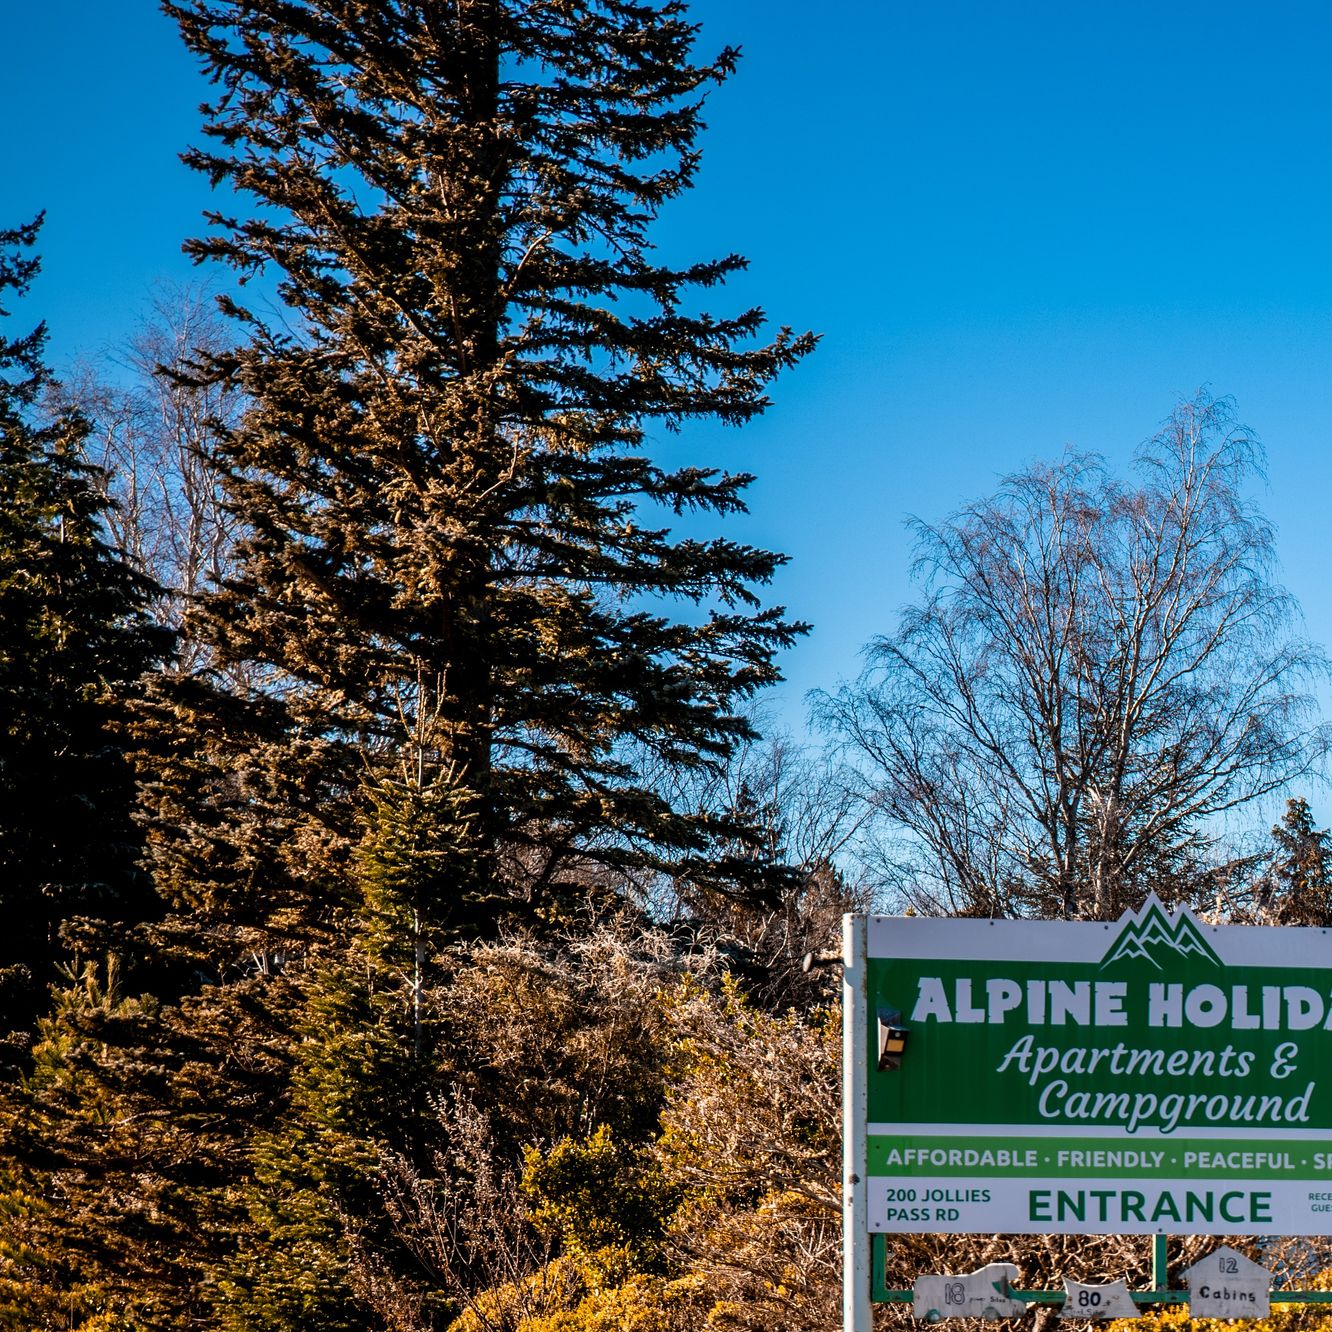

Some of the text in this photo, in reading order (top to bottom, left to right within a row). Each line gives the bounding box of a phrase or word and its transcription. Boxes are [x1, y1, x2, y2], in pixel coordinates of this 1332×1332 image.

[911, 976, 1128, 1026] ALPINE
[997, 1034, 1299, 1085] Apartments &
[1038, 1078, 1315, 1133] Campground
[886, 1149, 1038, 1168] AFFORDABLE
[1057, 1150, 1165, 1169] FRIENDLY
[1184, 1151, 1296, 1169] PEACEFUL
[886, 1188, 991, 1203] 200 JOLLIES
[887, 1208, 960, 1221] PASS RD
[1029, 1190, 1273, 1223] ENTRANCE
[1219, 1257, 1239, 1274] 12
[944, 1282, 965, 1305] 18
[1078, 1290, 1101, 1307] 80
[1199, 1285, 1256, 1302] Cabins
